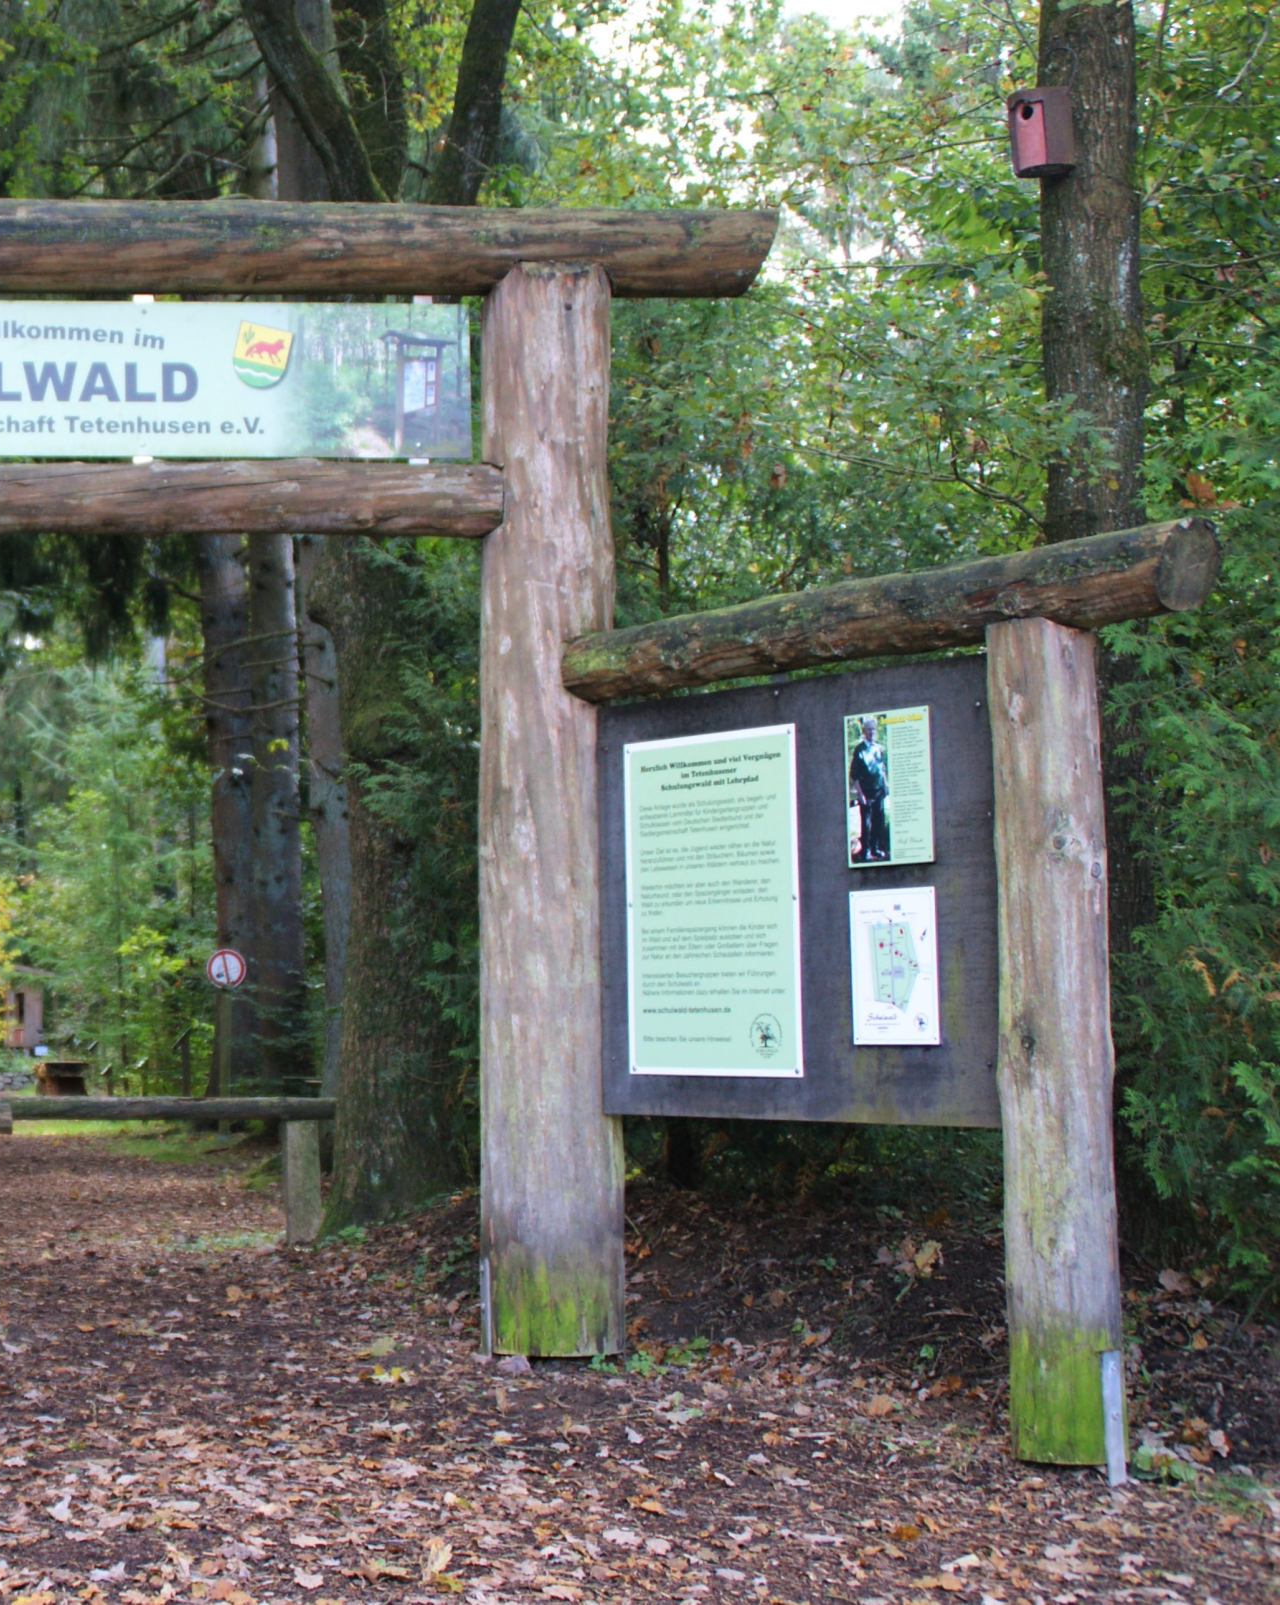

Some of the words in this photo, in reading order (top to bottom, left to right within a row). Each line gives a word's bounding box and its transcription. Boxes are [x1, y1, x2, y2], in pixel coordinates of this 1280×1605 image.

[134, 327, 165, 351] im
[64, 414, 211, 435] Tetenhusen
[220, 415, 265, 436] e.V.
[640, 764, 668, 773] Herzlich
[669, 759, 712, 769] Willkommen
[714, 757, 727, 765] und
[729, 755, 741, 763] viel
[743, 751, 781, 762] Vergnügen
[691, 767, 737, 777] Tetenhusener
[661, 780, 711, 791] Schulungswald
[727, 775, 759, 785] Lehrpfad
